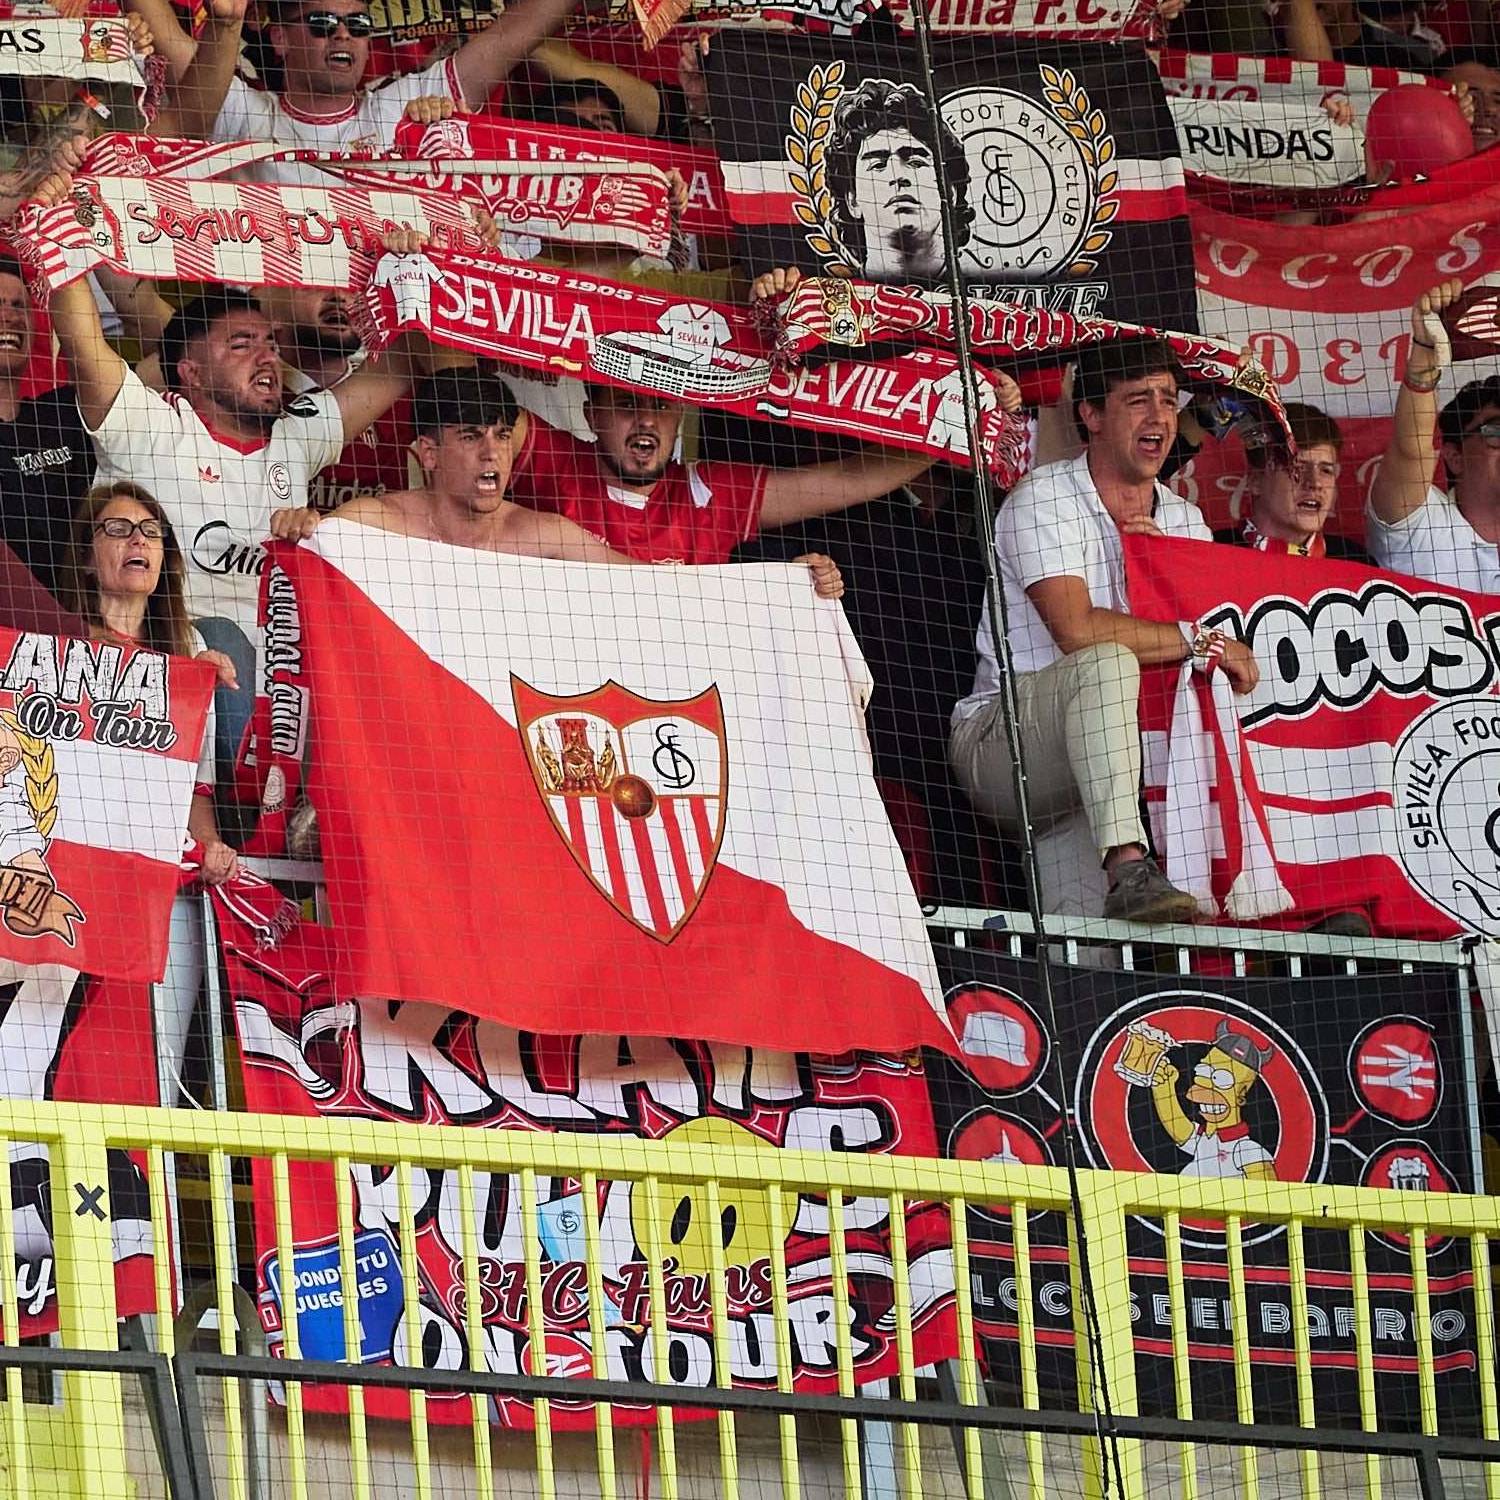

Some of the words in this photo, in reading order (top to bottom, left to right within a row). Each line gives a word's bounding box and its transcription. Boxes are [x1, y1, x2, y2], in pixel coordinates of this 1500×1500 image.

[945, 104, 1005, 131] FOOT
[1018, 111, 1069, 152] BALL
[1063, 164, 1077, 227] CLUB
[1184, 123, 1335, 162] RINDAS
[129, 201, 265, 245] Sevilla
[451, 257, 530, 287] DESDE
[564, 281, 631, 302] 1905
[438, 273, 596, 352] SEVILLA
[767, 360, 931, 424] SEVILLA
[18, 692, 85, 738] On
[90, 700, 177, 751] Tour
[1408, 744, 1452, 848] SEVILLA
[361, 1246, 388, 1274] TÚ
[296, 1276, 388, 1312] JUEGES
[456, 1256, 588, 1322] SFC
[619, 1256, 772, 1328] Fans
